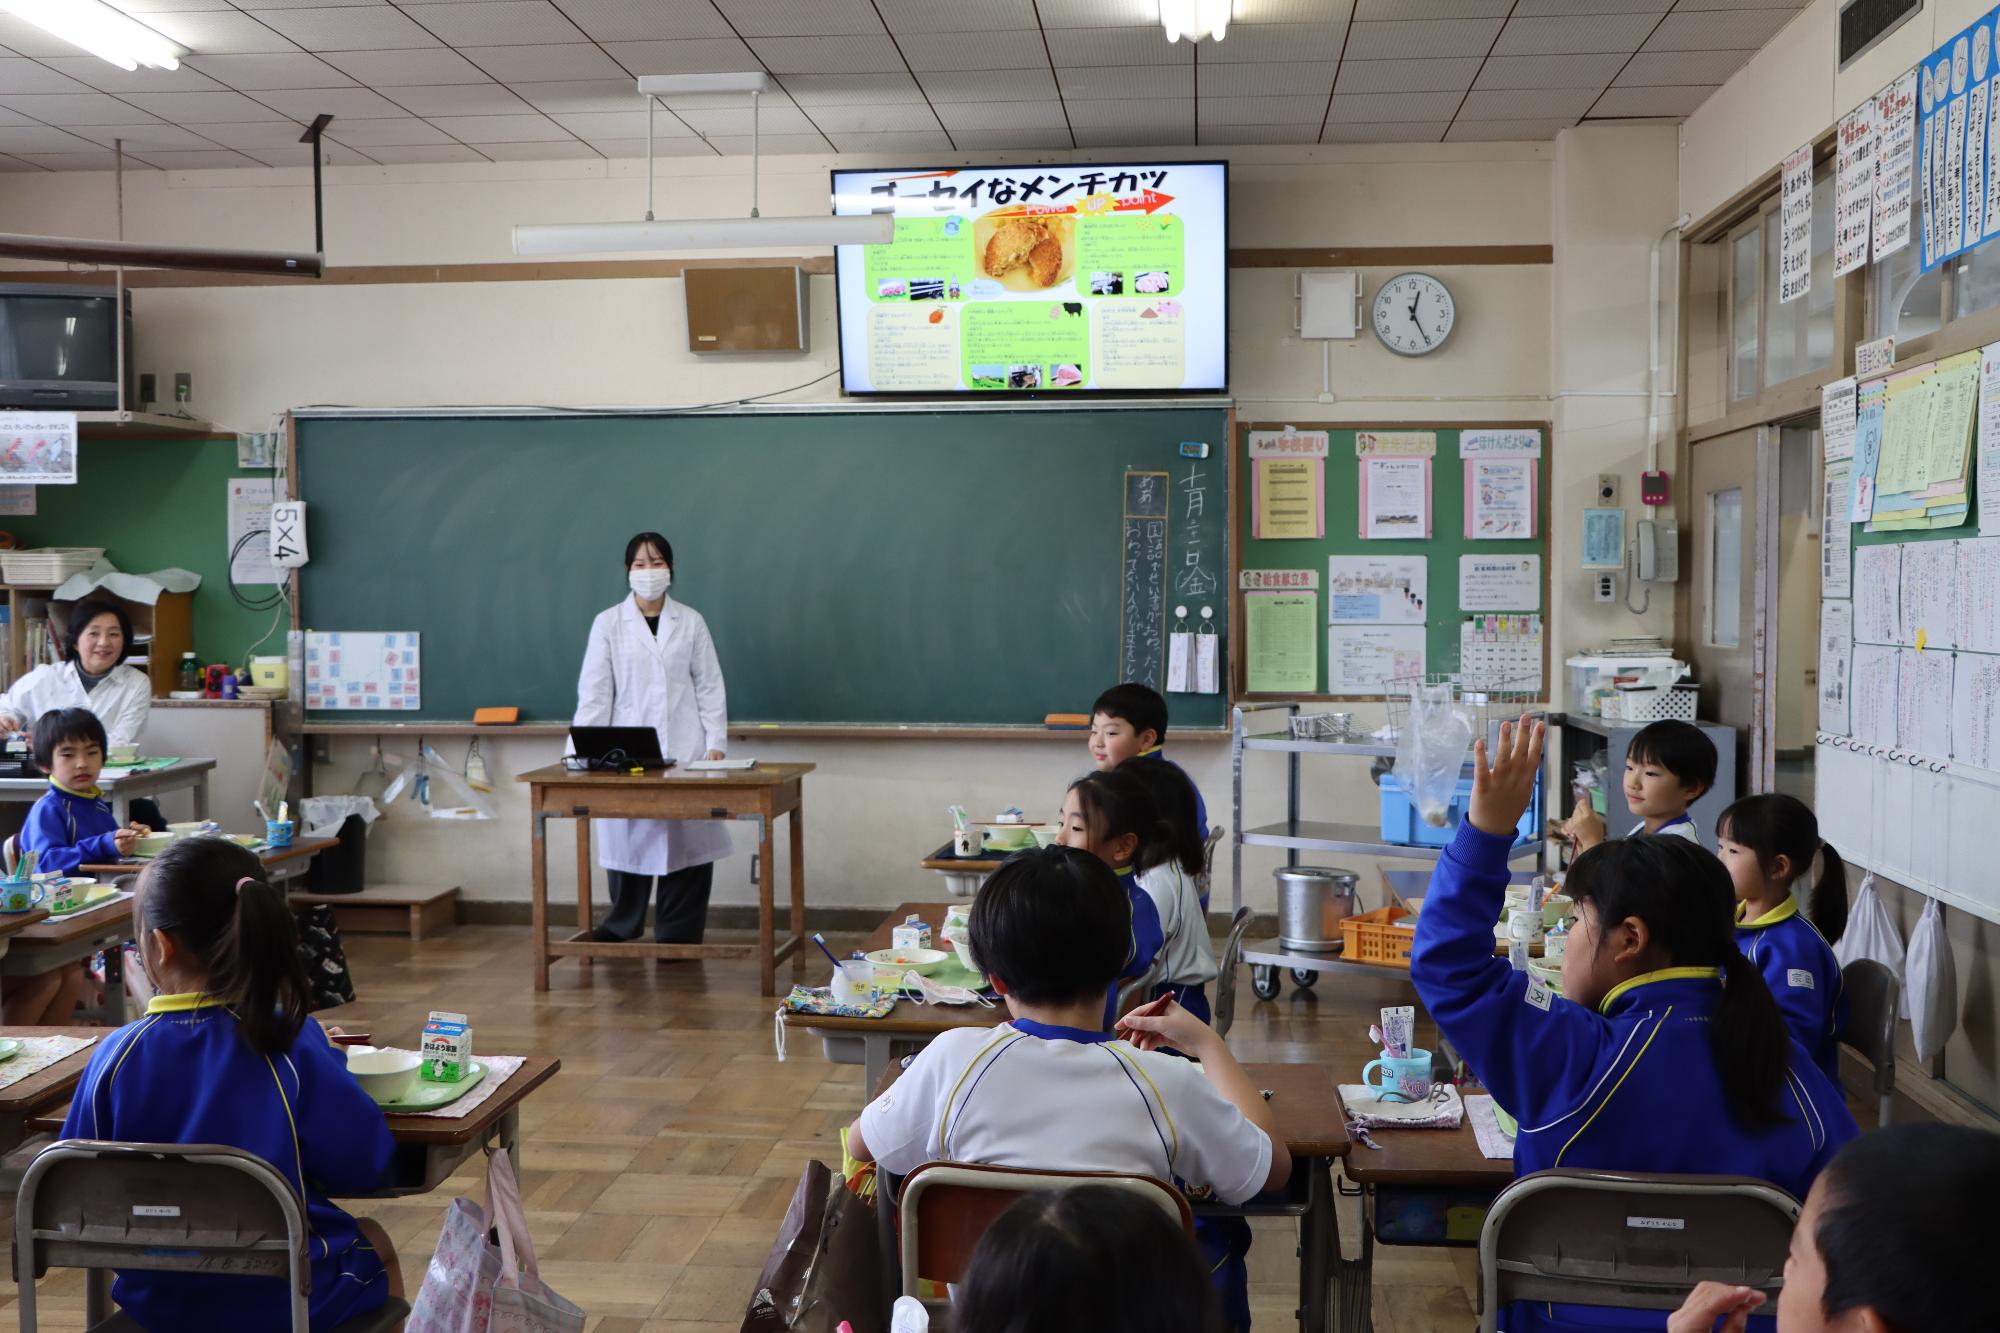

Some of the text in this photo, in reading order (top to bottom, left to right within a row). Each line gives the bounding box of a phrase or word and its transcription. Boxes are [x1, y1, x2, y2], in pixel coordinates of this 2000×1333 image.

[424, 1042, 457, 1053] おはよう家族
